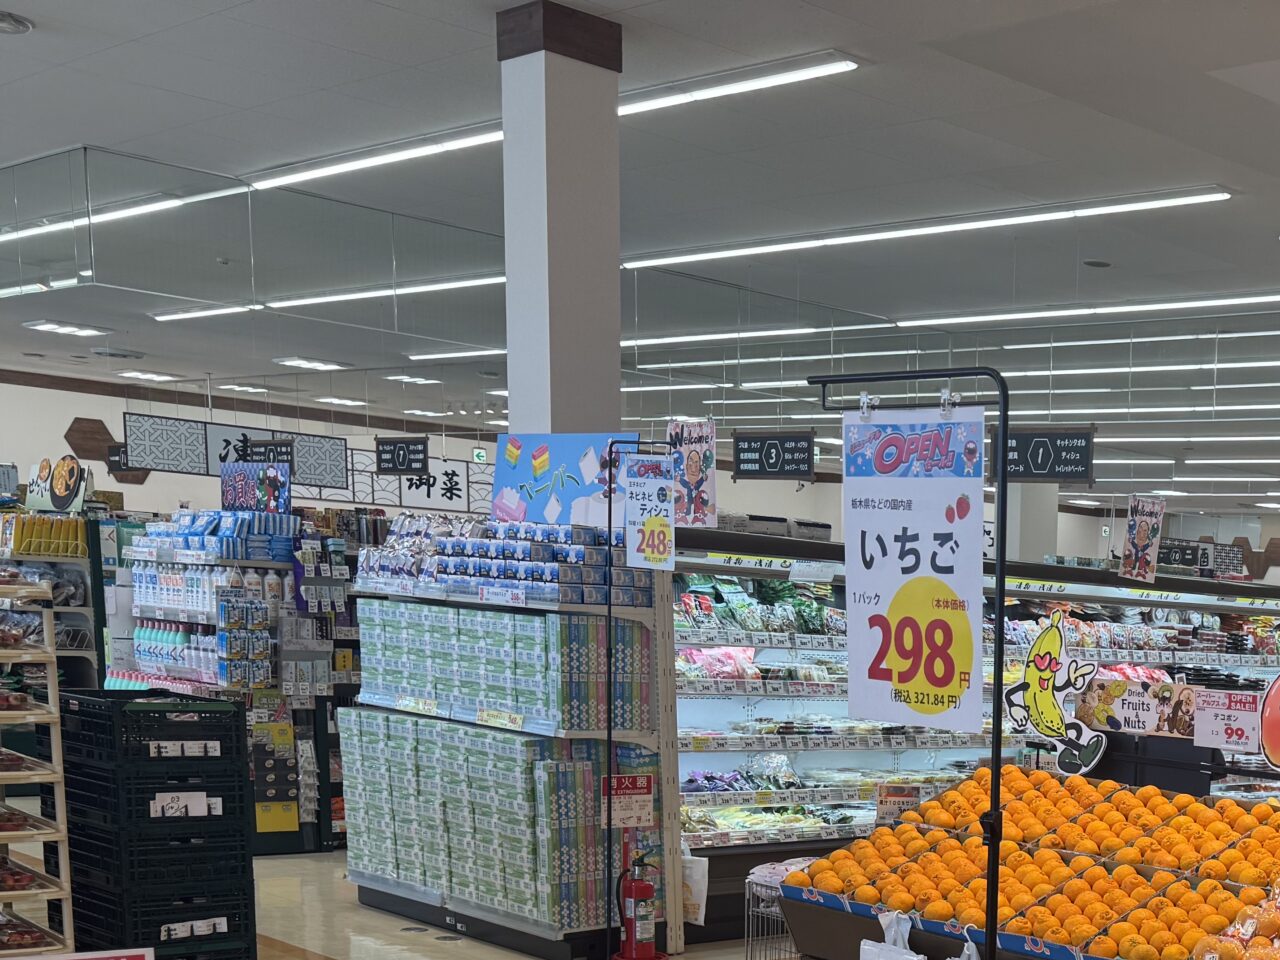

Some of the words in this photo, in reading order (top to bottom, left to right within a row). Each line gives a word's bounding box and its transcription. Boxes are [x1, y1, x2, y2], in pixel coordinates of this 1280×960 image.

[669, 423, 714, 450] Welcome!
[399, 450, 404, 462] 7
[769, 448, 777, 464] 3
[873, 426, 953, 475] OPEN
[1038, 447, 1044, 465] 1
[639, 503, 669, 518] ティシュ
[851, 497, 913, 511] 栃木県などの国内産
[1130, 500, 1162, 519] Welcome!
[636, 528, 667, 556] 248
[860, 526, 960, 575] いちご
[1172, 550, 1181, 561] 10
[852, 591, 881, 607] 1パック
[1127, 688, 1145, 698] Dried
[1231, 694, 1253, 702] OPEN
[1121, 698, 1151, 712] Fruits
[1230, 702, 1256, 712] SALE!!
[1123, 716, 1147, 730] Nuts
